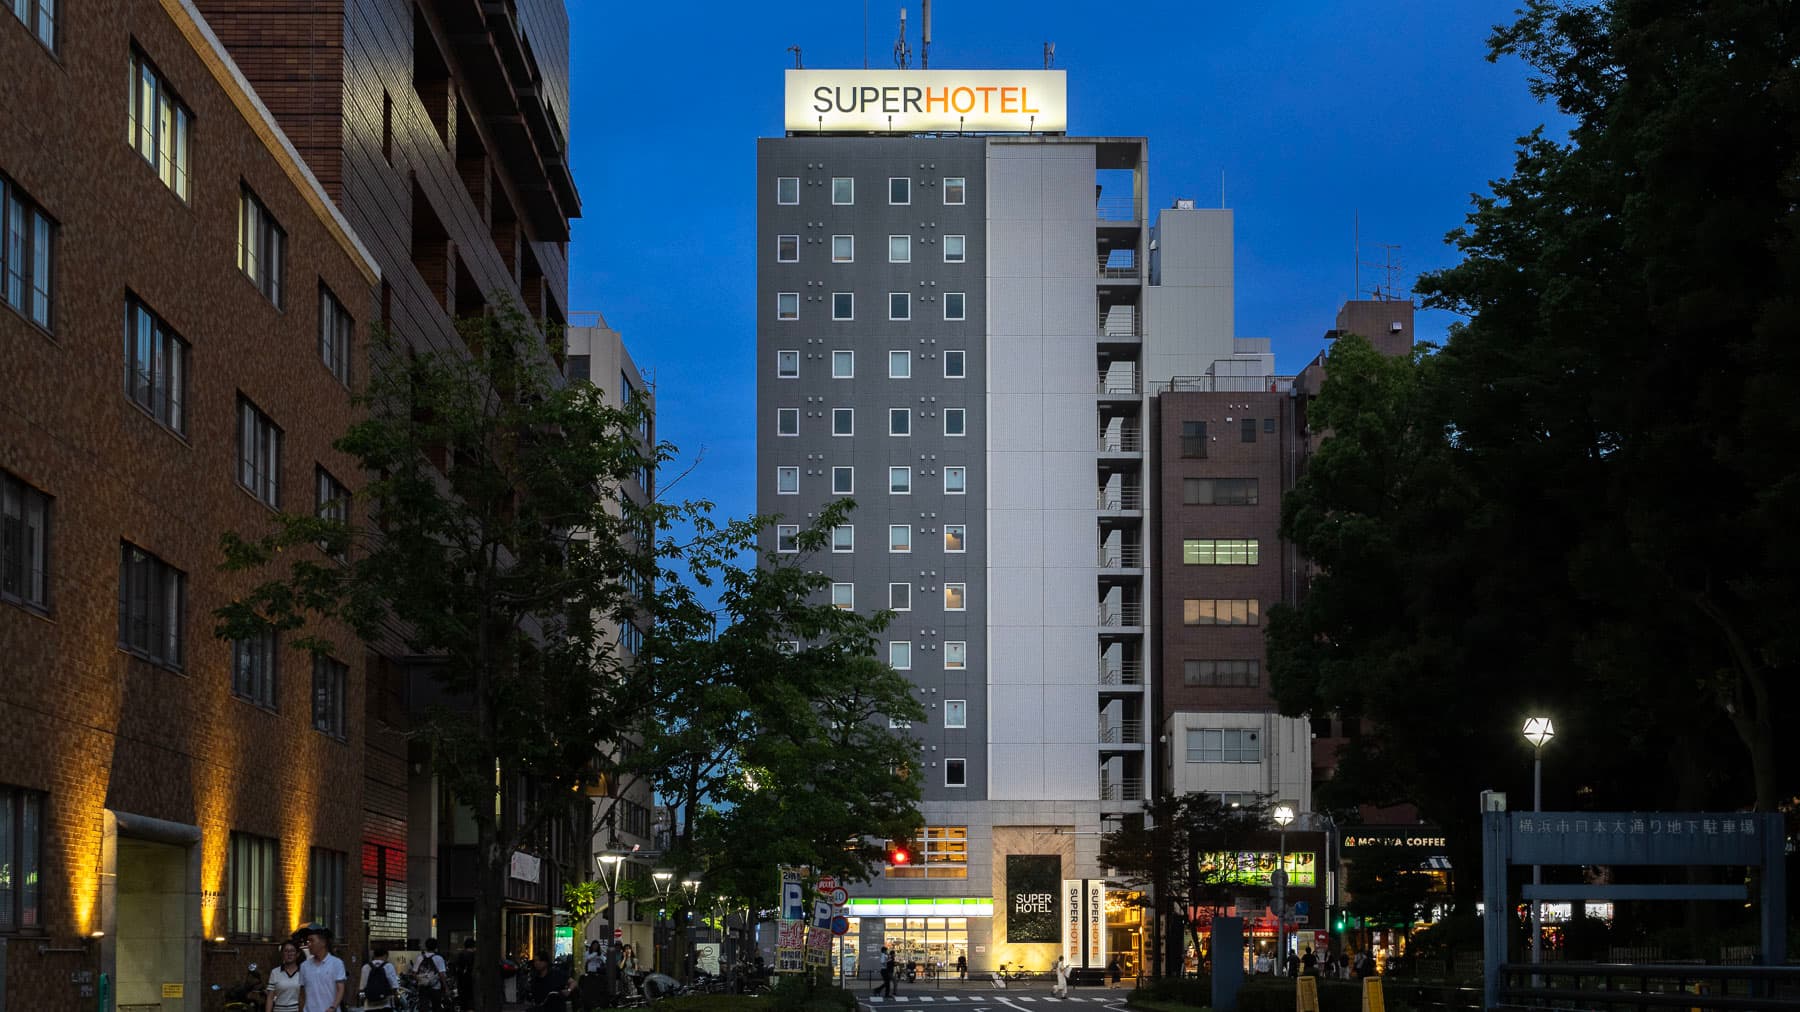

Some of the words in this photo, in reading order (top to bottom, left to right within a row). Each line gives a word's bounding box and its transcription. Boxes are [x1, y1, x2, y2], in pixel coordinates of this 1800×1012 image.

[1519, 818, 1756, 835] 横浜市日本大通り地下駐車場
[1406, 837, 1446, 847] COFFEE
[1016, 893, 1052, 903] SUPER
[1016, 903, 1052, 913] HOTEL
[814, 903, 832, 927] P
